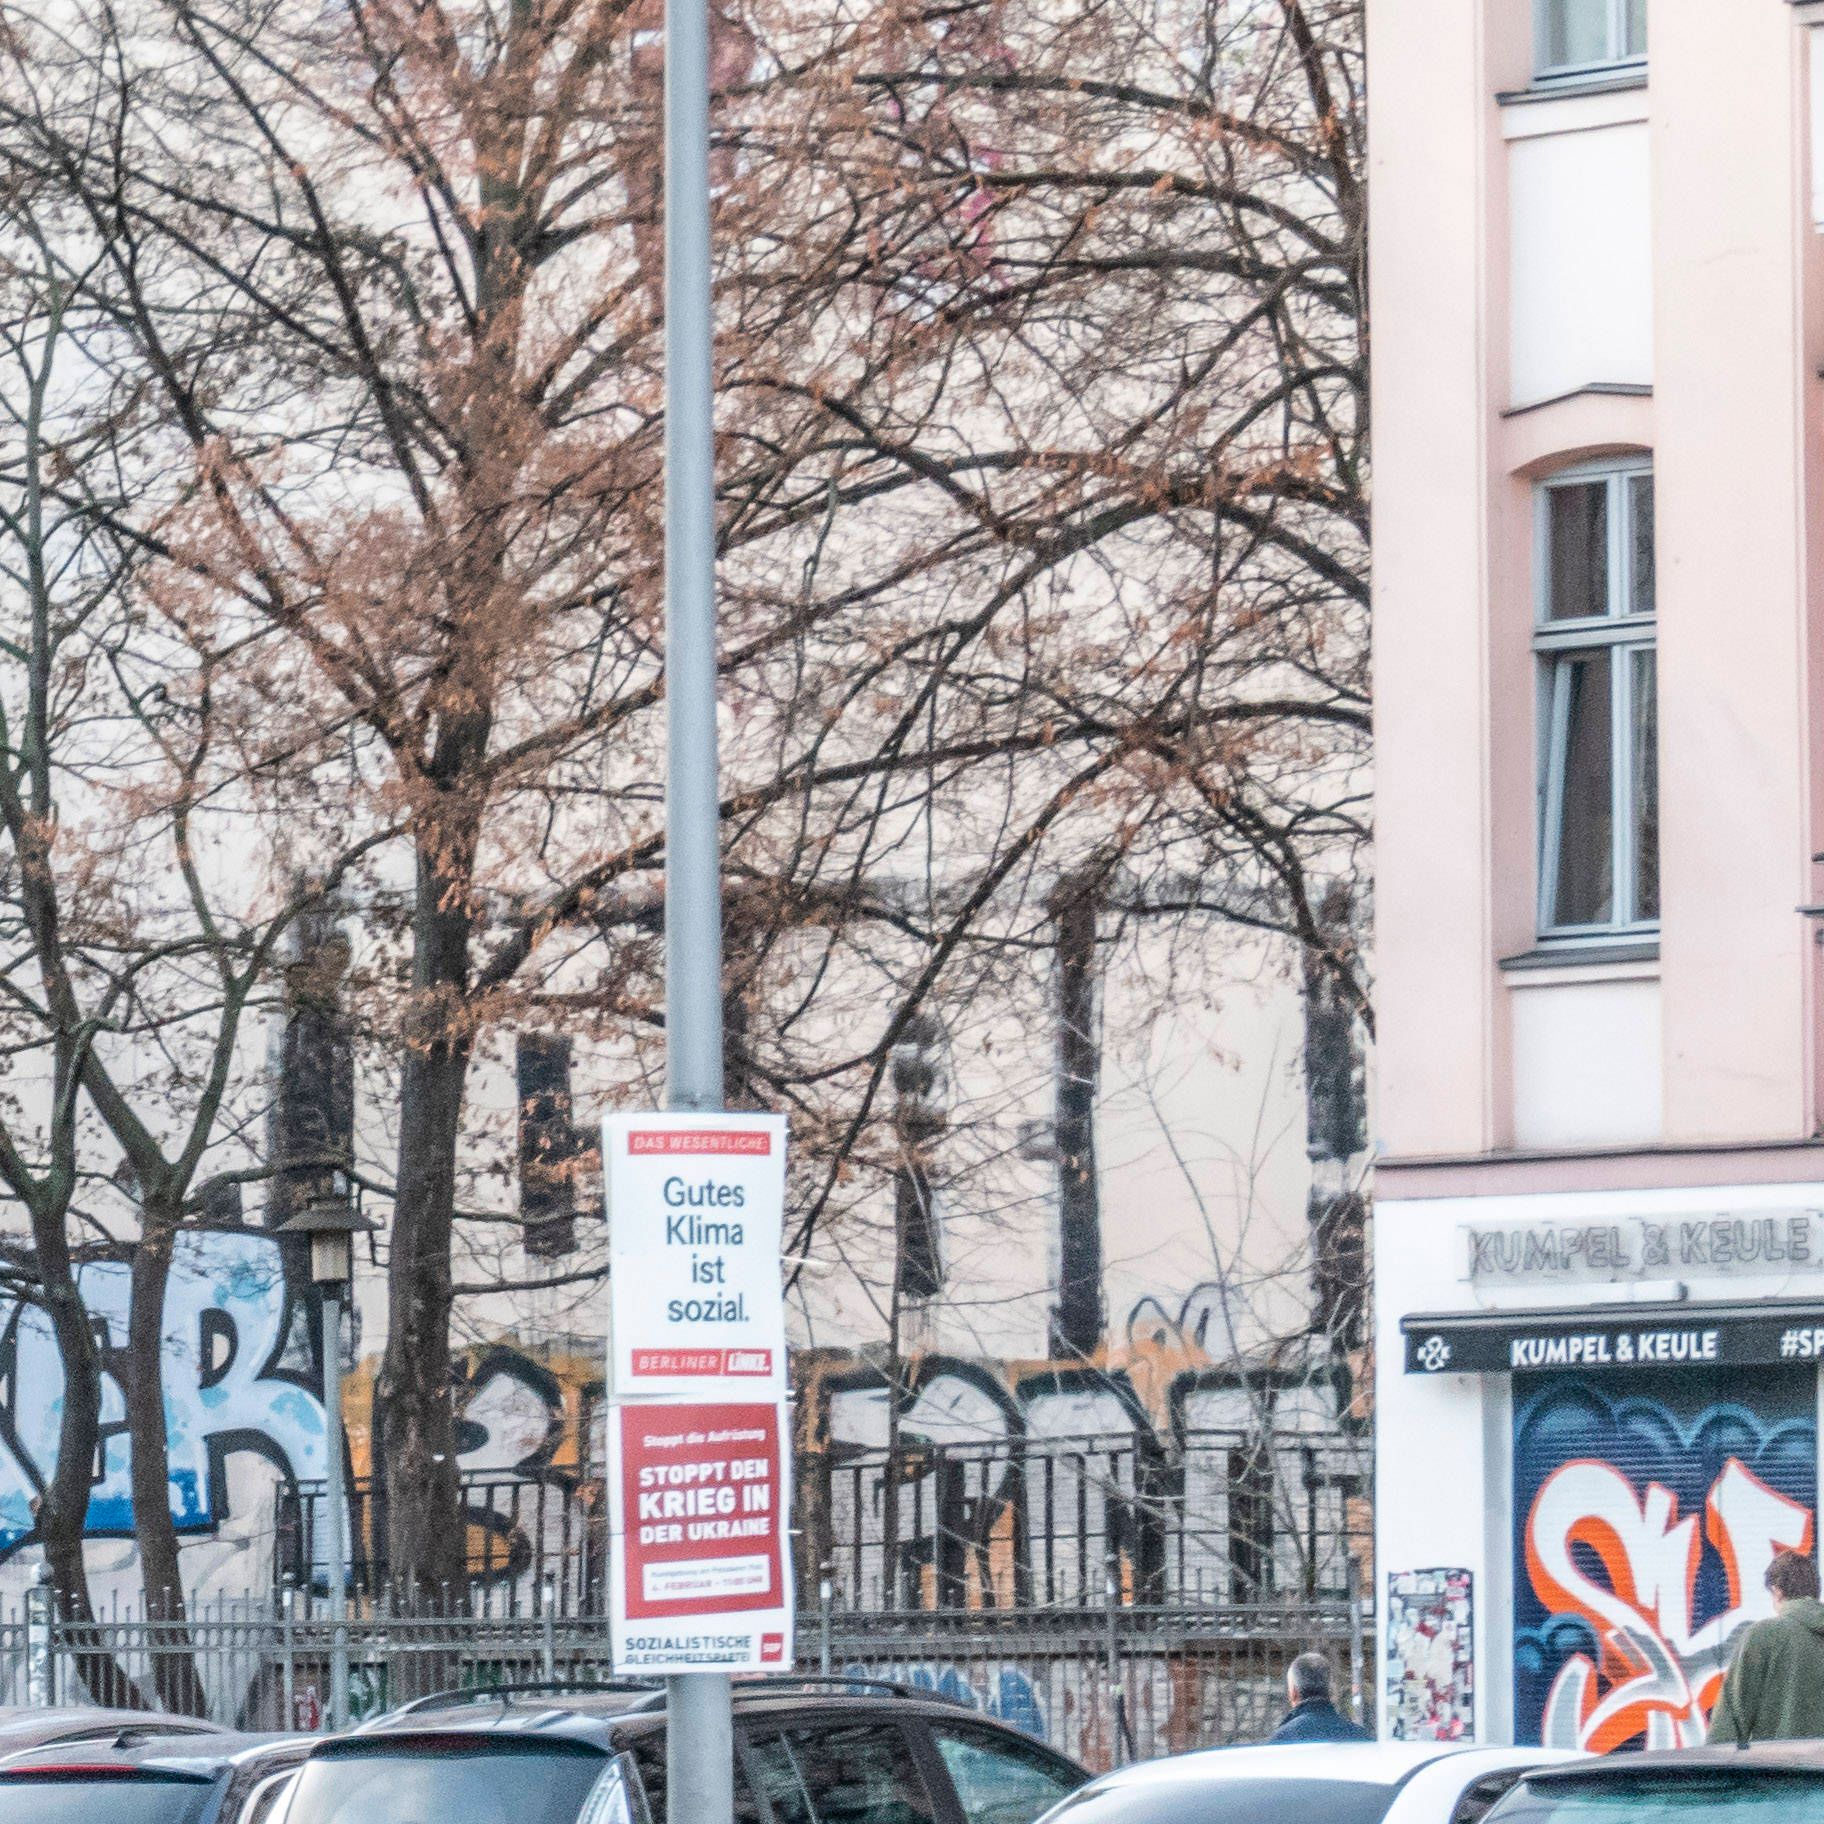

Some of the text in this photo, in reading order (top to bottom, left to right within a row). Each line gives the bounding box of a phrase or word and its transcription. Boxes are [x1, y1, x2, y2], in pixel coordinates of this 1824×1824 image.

[633, 1136, 664, 1149] DAS
[663, 1176, 745, 1207] Gutes
[666, 1215, 744, 1245] Klima
[1469, 1217, 1811, 1272] KUMPEL & KEULE
[692, 1253, 726, 1283] ist
[667, 1292, 750, 1322] sozial.
[638, 1355, 718, 1370] BERLINER
[1511, 1331, 1720, 1367] KUMPEL & KEULE
[642, 1433, 683, 1448] Stoppt
[639, 1459, 769, 1488] STOPPT DEN
[639, 1484, 771, 1520] KRIEG IN
[639, 1517, 771, 1545] DER UKRAINE
[624, 1634, 752, 1650] SOZIALISTISCHE
